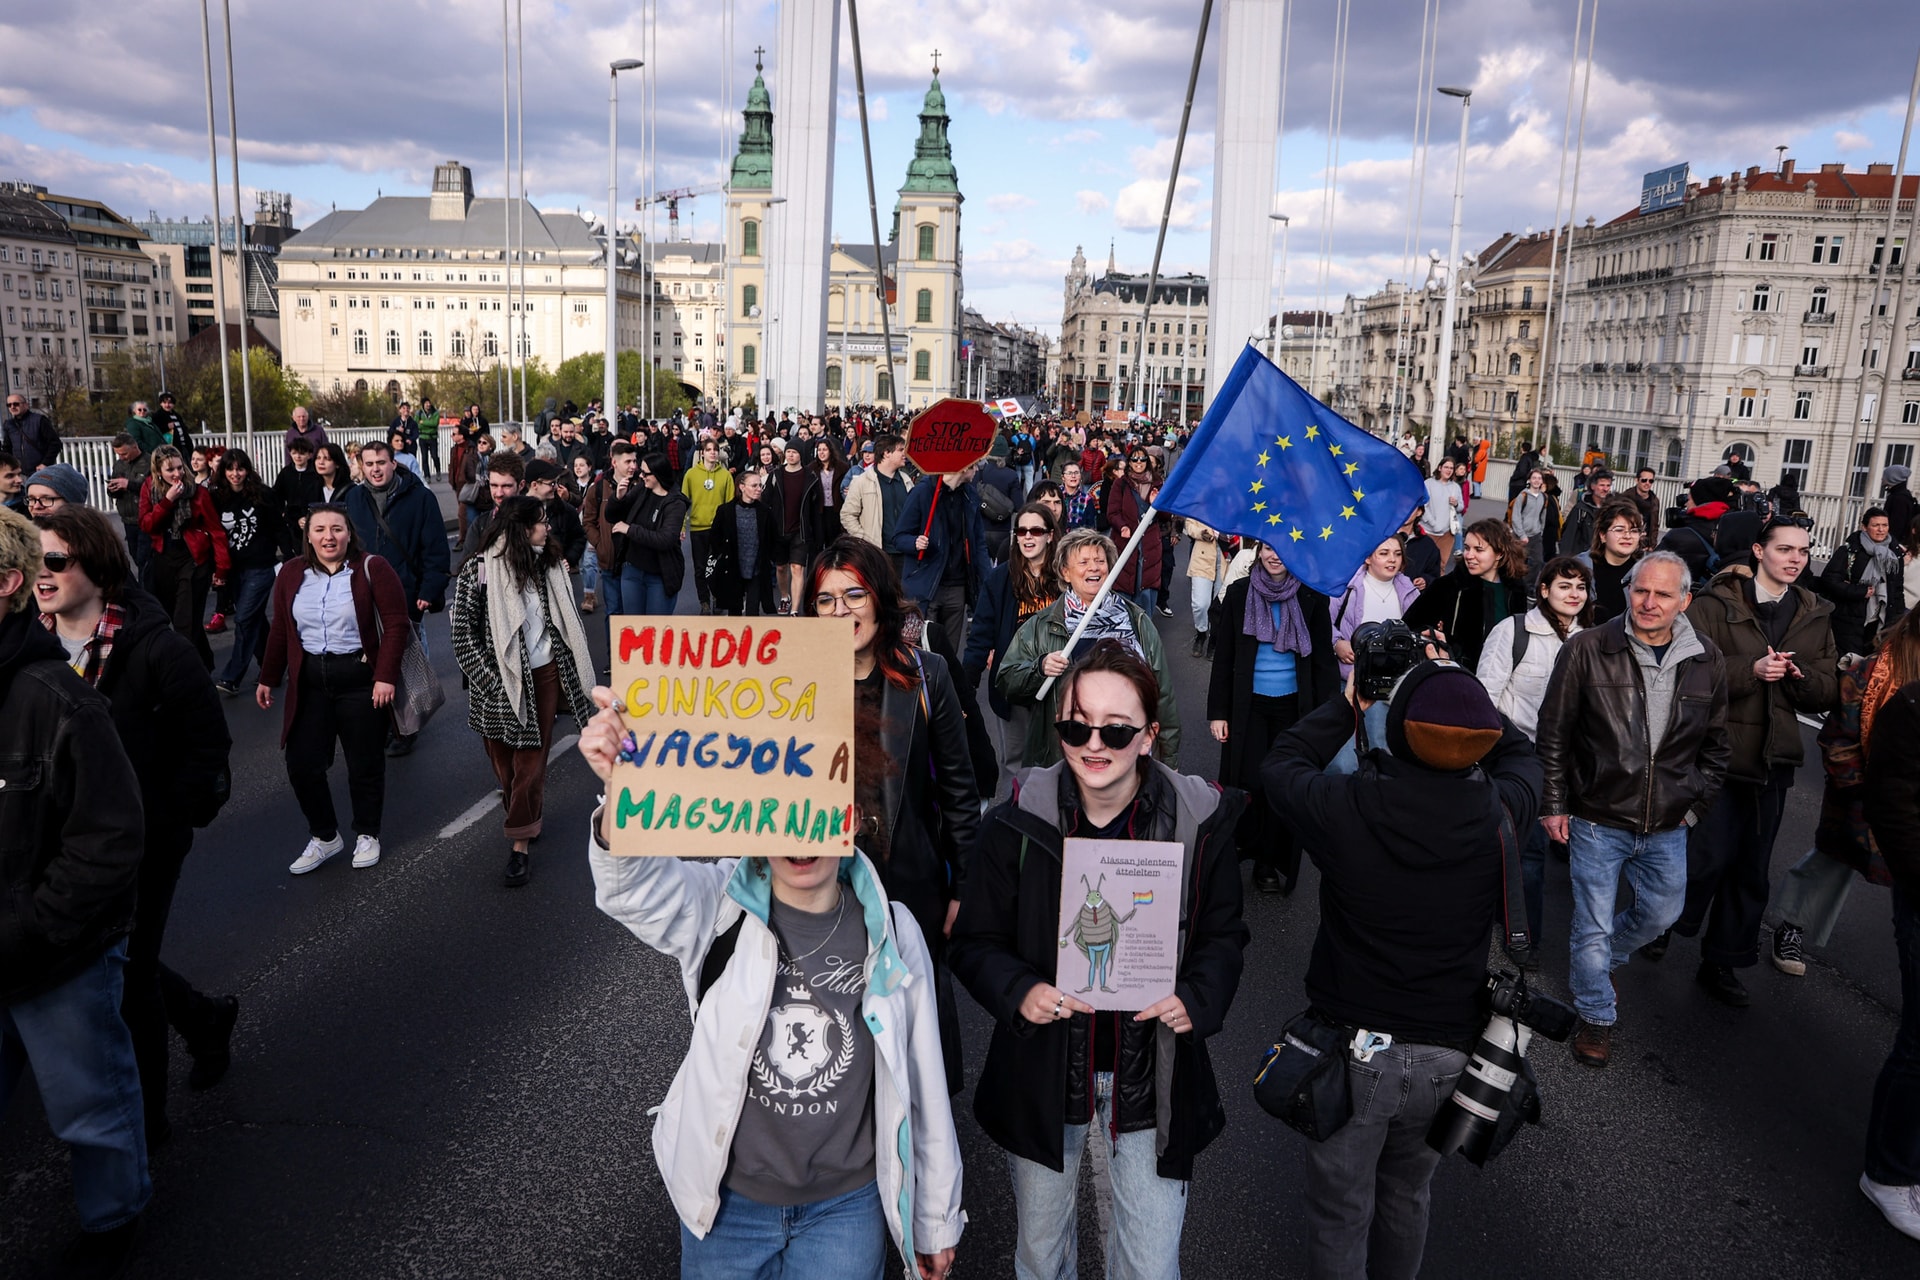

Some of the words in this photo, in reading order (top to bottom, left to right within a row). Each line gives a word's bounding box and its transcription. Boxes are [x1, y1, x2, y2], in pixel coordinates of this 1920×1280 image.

[926, 421, 972, 437] STOP
[619, 625, 782, 669] MINDIG
[625, 675, 817, 722] CINKOSA
[627, 728, 816, 778] VAGYOK
[829, 742, 850, 784] A
[616, 786, 853, 847] MAGYARNAK!
[1135, 858, 1178, 868] jelentem,
[810, 955, 866, 995] Hill
[749, 1087, 838, 1116] LONDON
